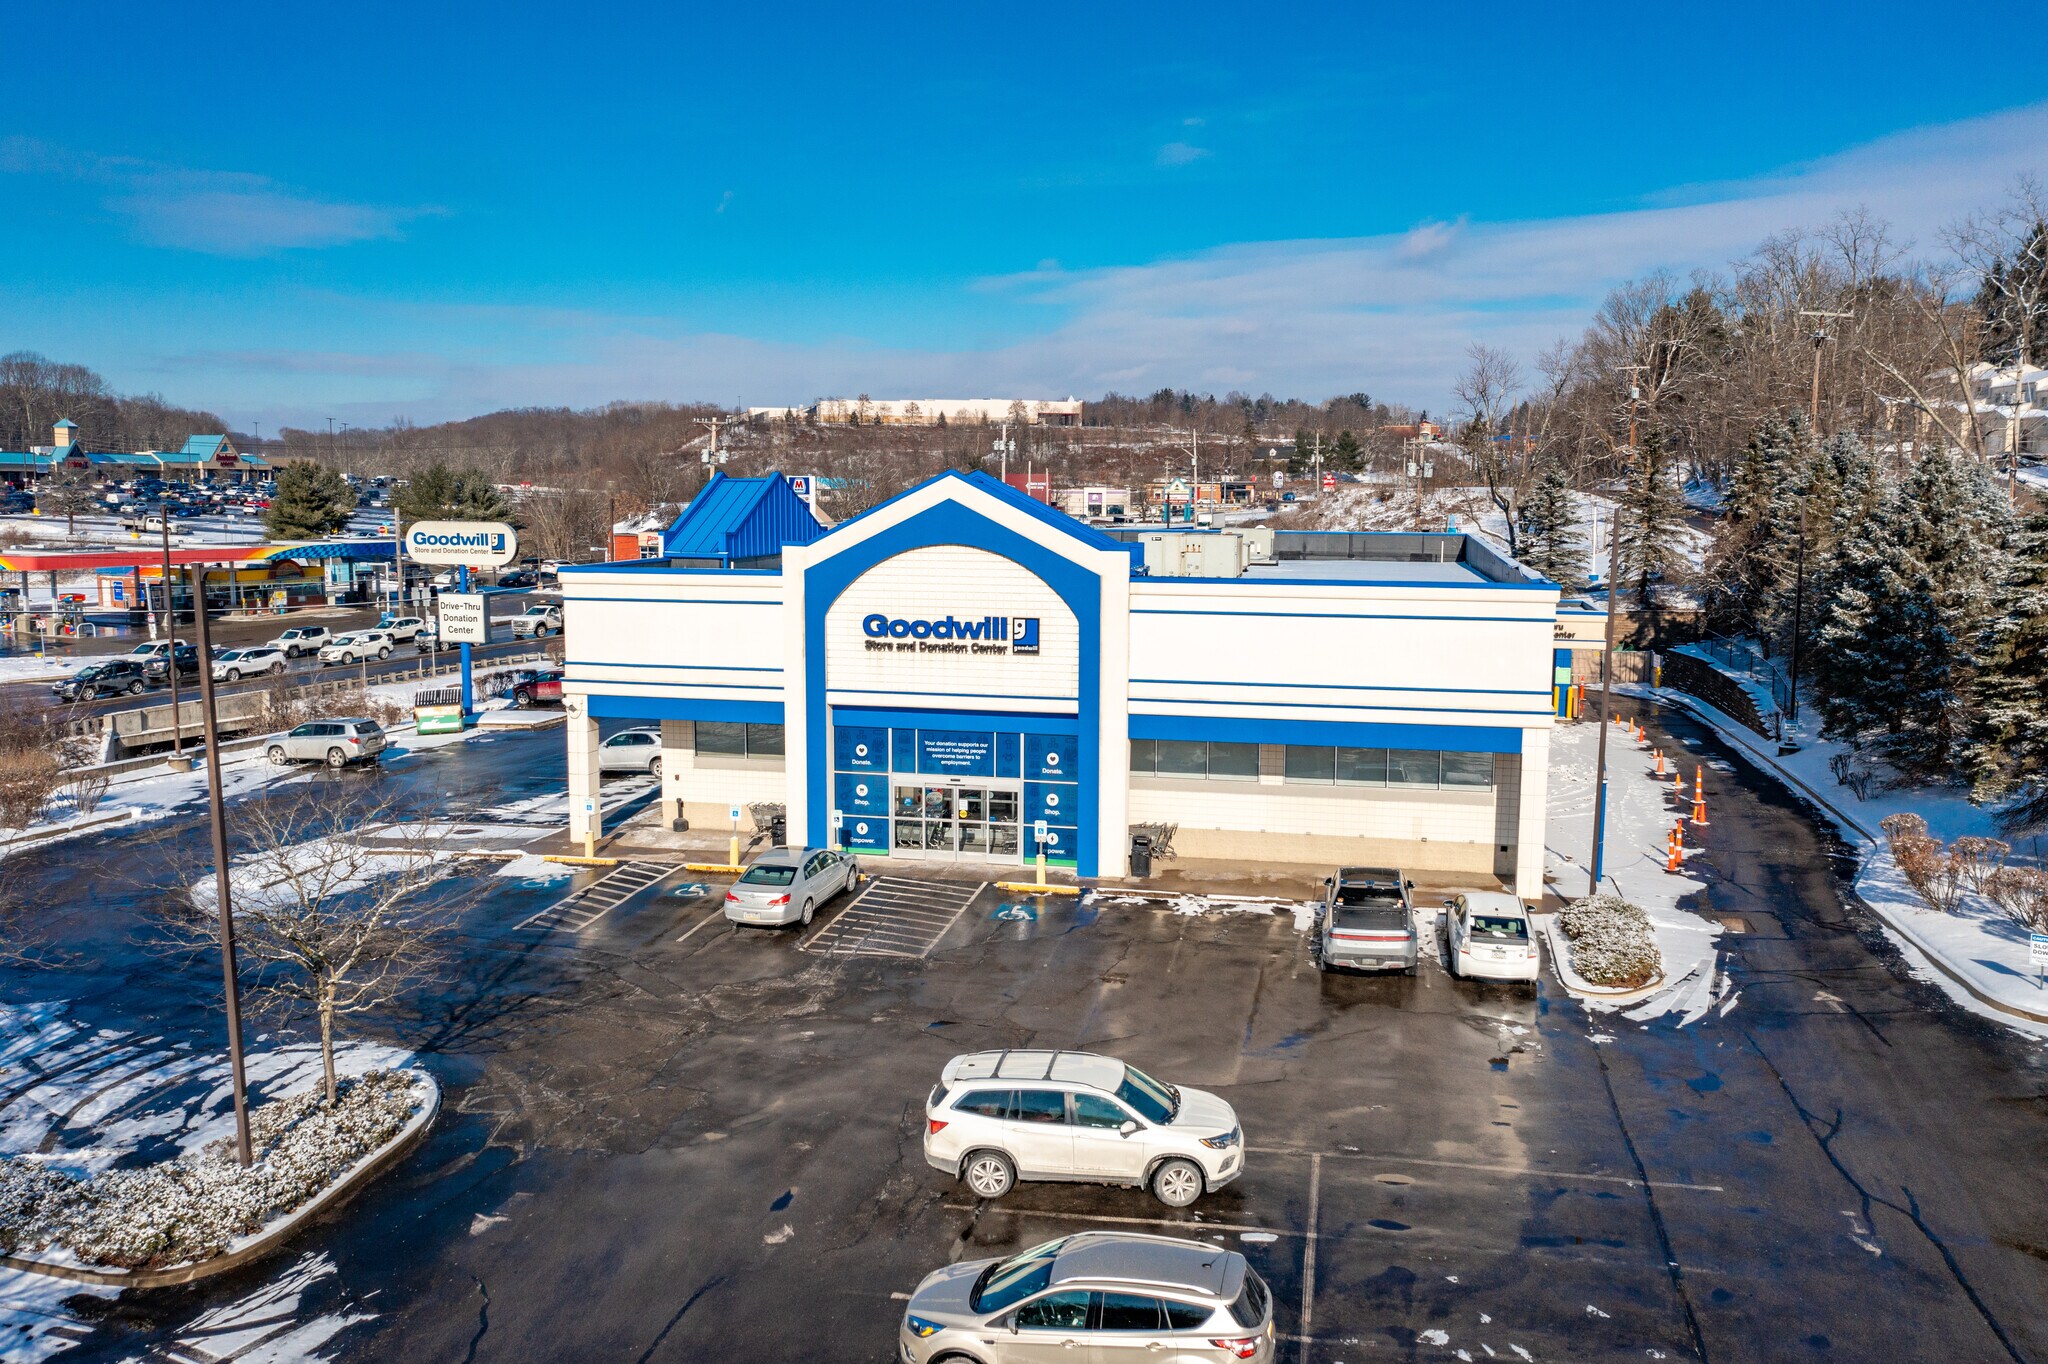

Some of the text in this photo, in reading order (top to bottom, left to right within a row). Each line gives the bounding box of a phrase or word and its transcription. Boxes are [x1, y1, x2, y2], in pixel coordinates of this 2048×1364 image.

[413, 532, 489, 546] Goodwill
[440, 602, 481, 611] Drive-Thru
[443, 614, 478, 622] Donation
[447, 626, 474, 634] Center
[862, 613, 1008, 641] Goodwill
[864, 640, 1008, 655] Store and Donation Center
[1044, 808, 1060, 816] Shop.
